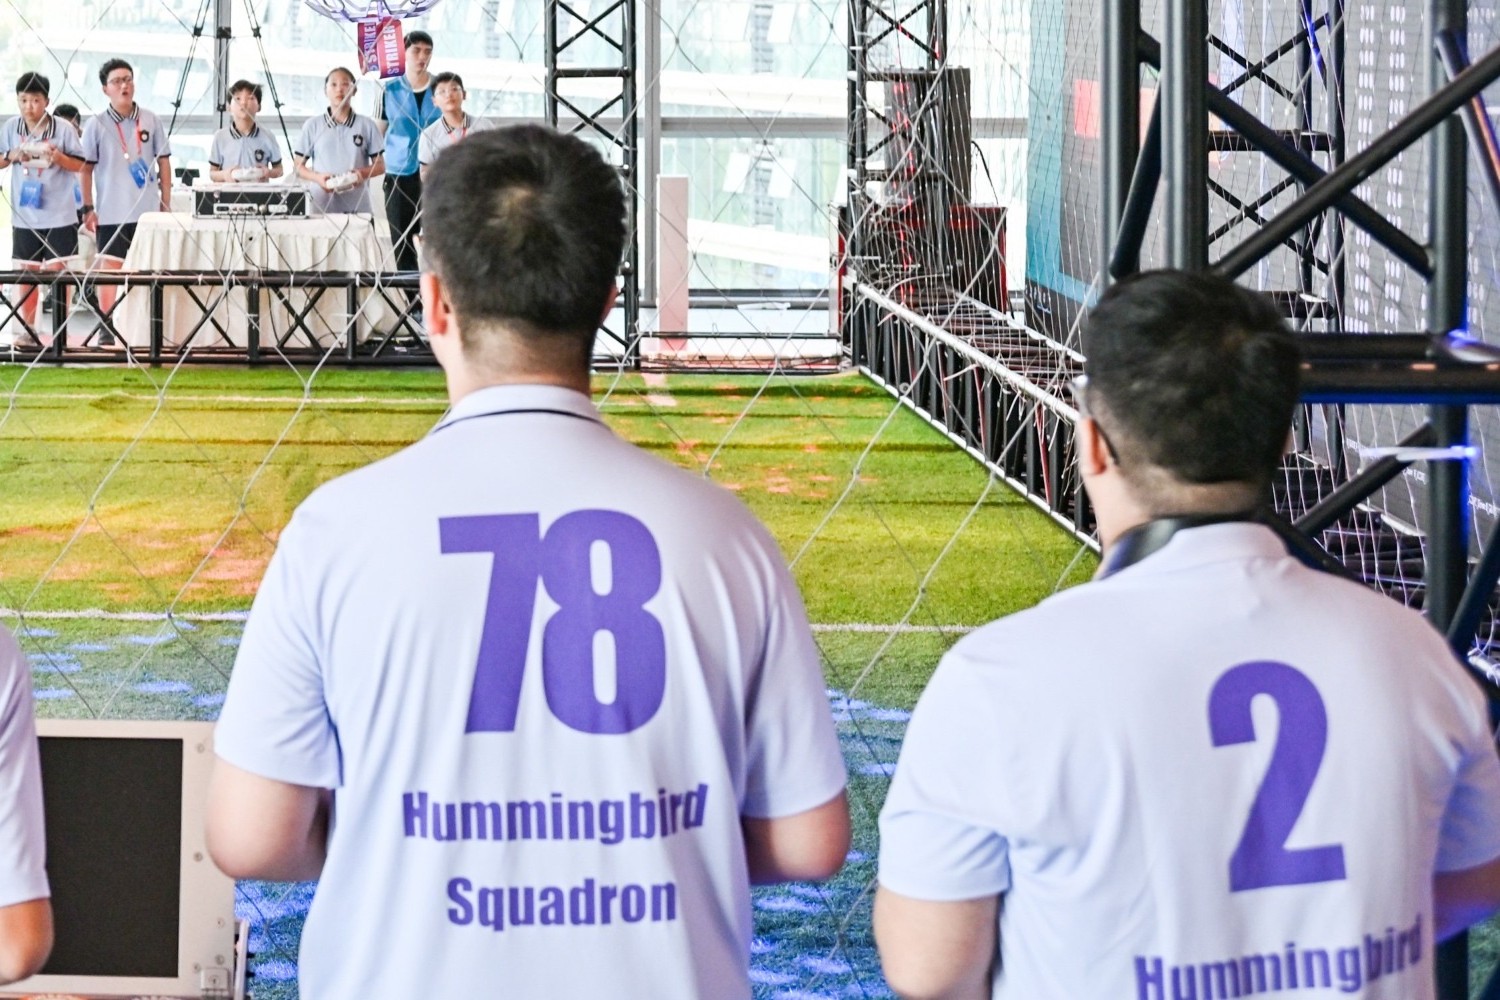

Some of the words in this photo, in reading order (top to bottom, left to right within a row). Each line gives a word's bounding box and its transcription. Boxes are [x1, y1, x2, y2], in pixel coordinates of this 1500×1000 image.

[439, 509, 666, 735] 78
[402, 783, 709, 845] Hummingbird
[1207, 660, 1347, 893] 2
[446, 876, 678, 932] Squadron
